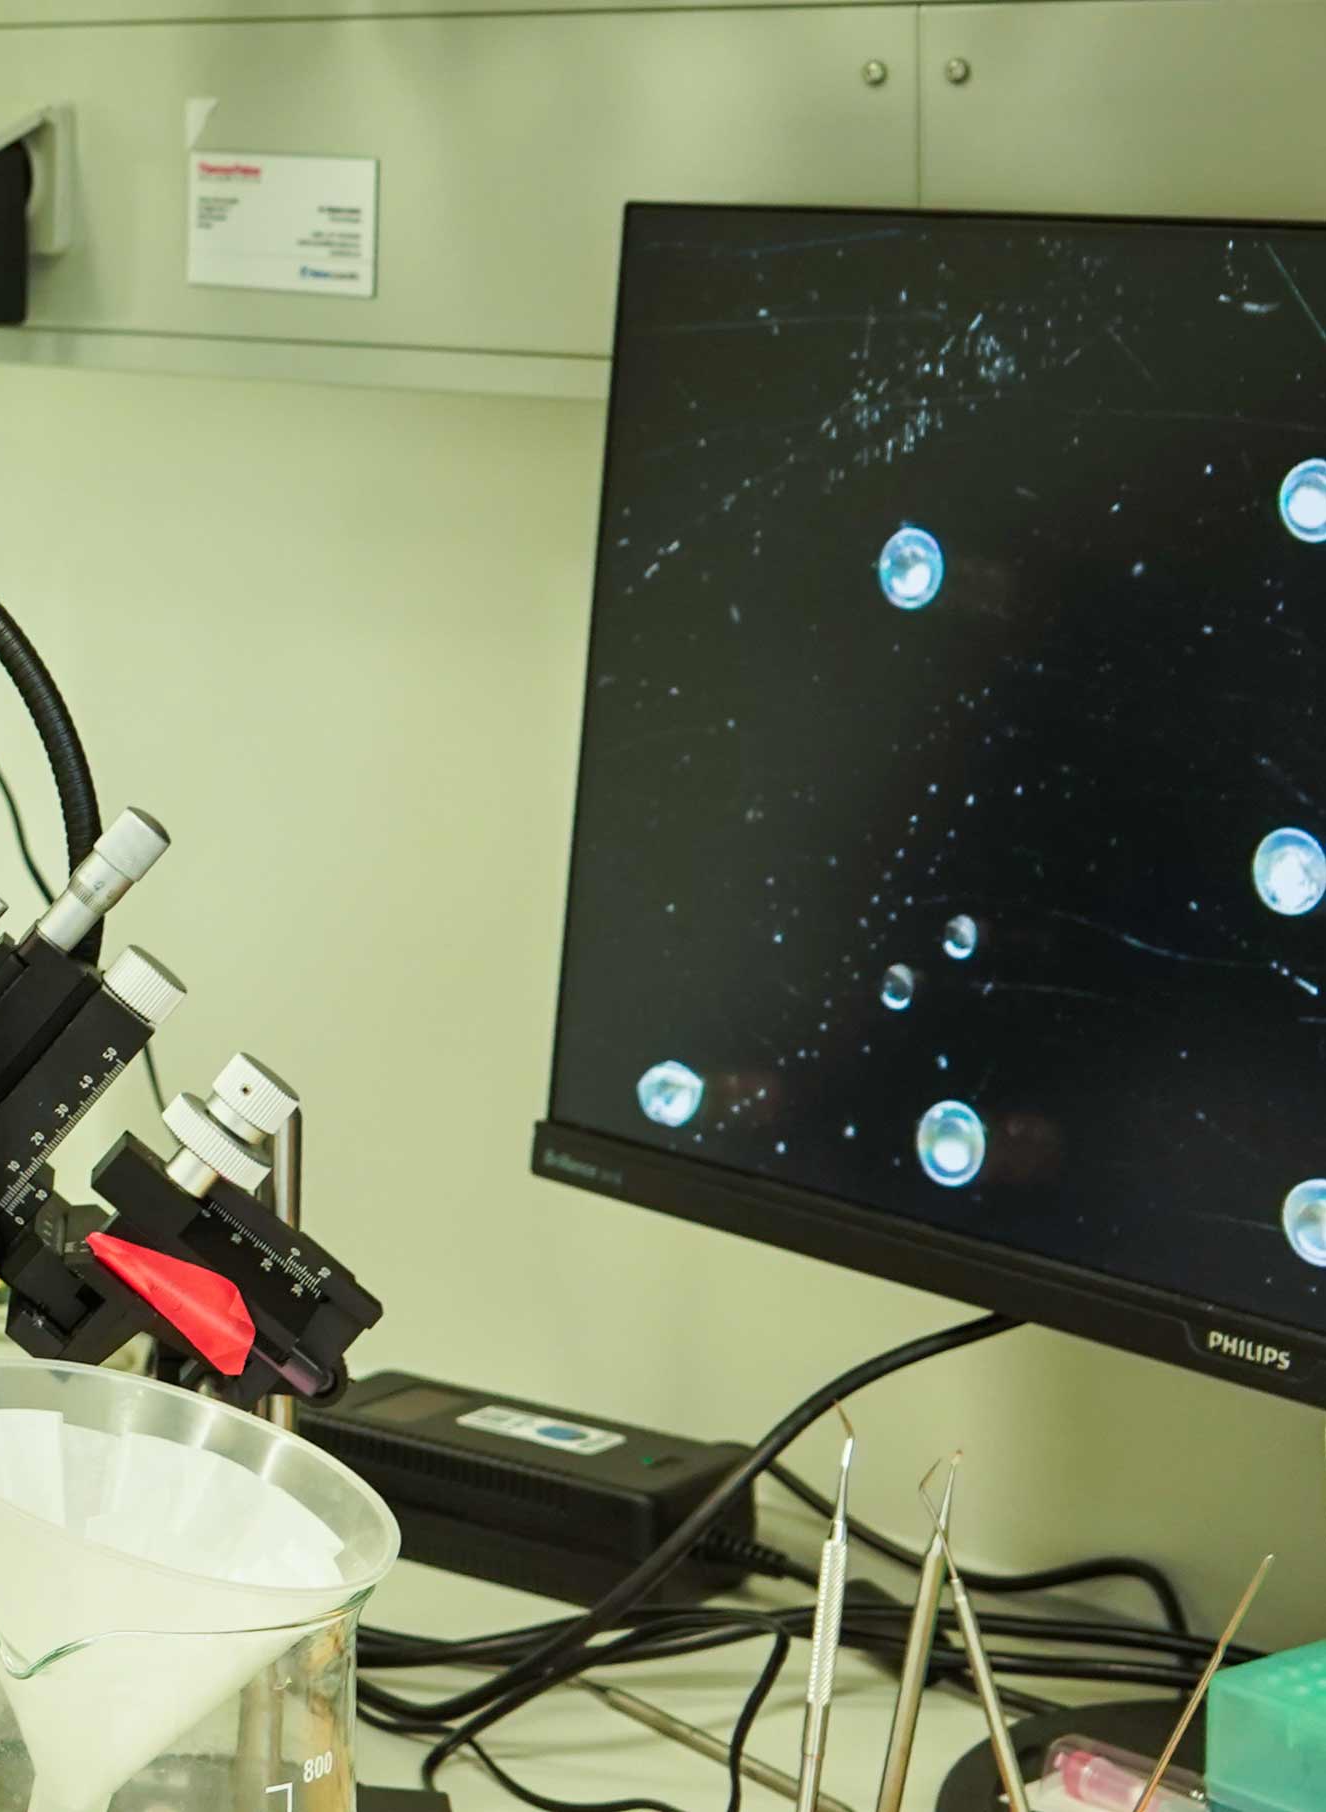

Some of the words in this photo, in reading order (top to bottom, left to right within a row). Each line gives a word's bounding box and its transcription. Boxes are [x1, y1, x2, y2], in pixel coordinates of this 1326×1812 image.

[102, 1046, 118, 1062] 50
[79, 1074, 94, 1090] 40
[54, 1103, 69, 1119] 30
[30, 1131, 45, 1147] 20
[7, 1159, 21, 1173] 10
[35, 1189, 48, 1201] 10
[14, 1215, 25, 1226] 0
[1208, 1330, 1291, 1371] PHILIPS
[303, 1751, 333, 1783] 800
